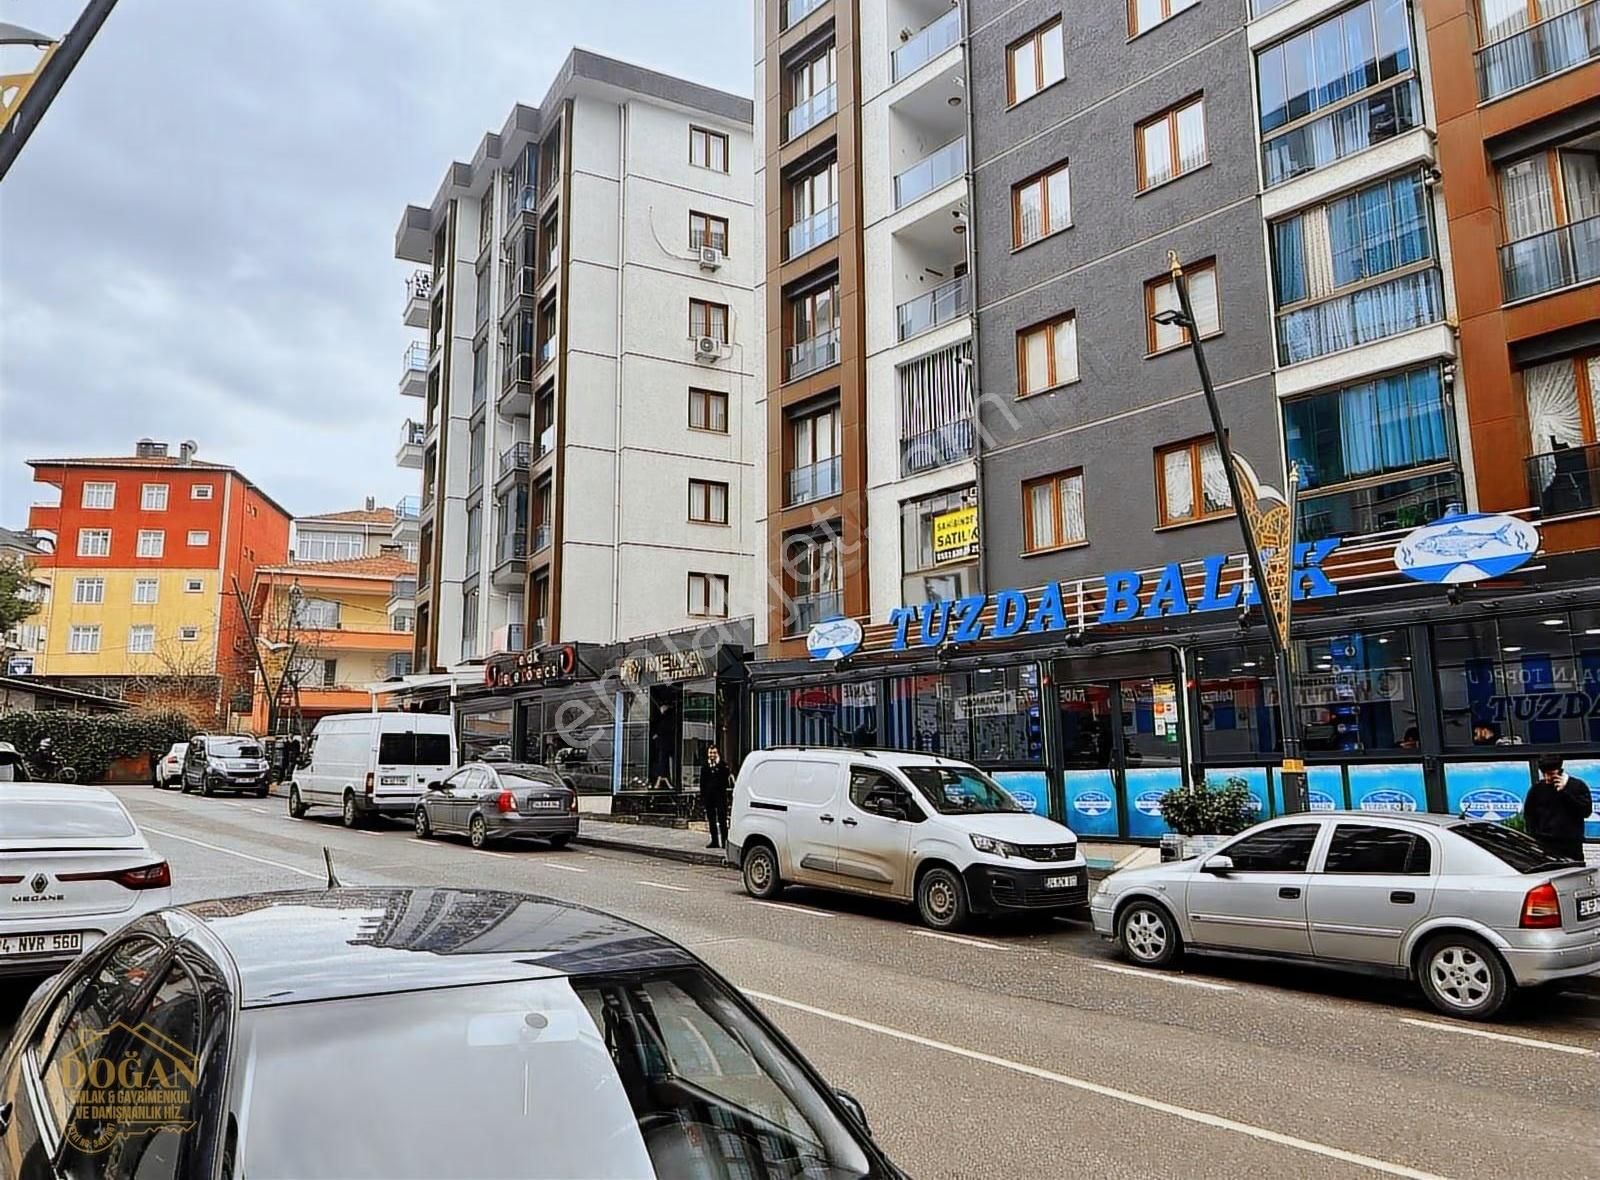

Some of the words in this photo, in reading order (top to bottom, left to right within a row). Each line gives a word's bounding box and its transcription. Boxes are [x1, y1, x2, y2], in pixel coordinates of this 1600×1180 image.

[936, 527, 980, 547] SATILK
[888, 580, 1068, 651] TUZDA
[1100, 536, 1342, 625] BALK
[11, 894, 65, 902] MEGANE
[18, 936, 46, 952] NVR
[53, 934, 79, 949] 560
